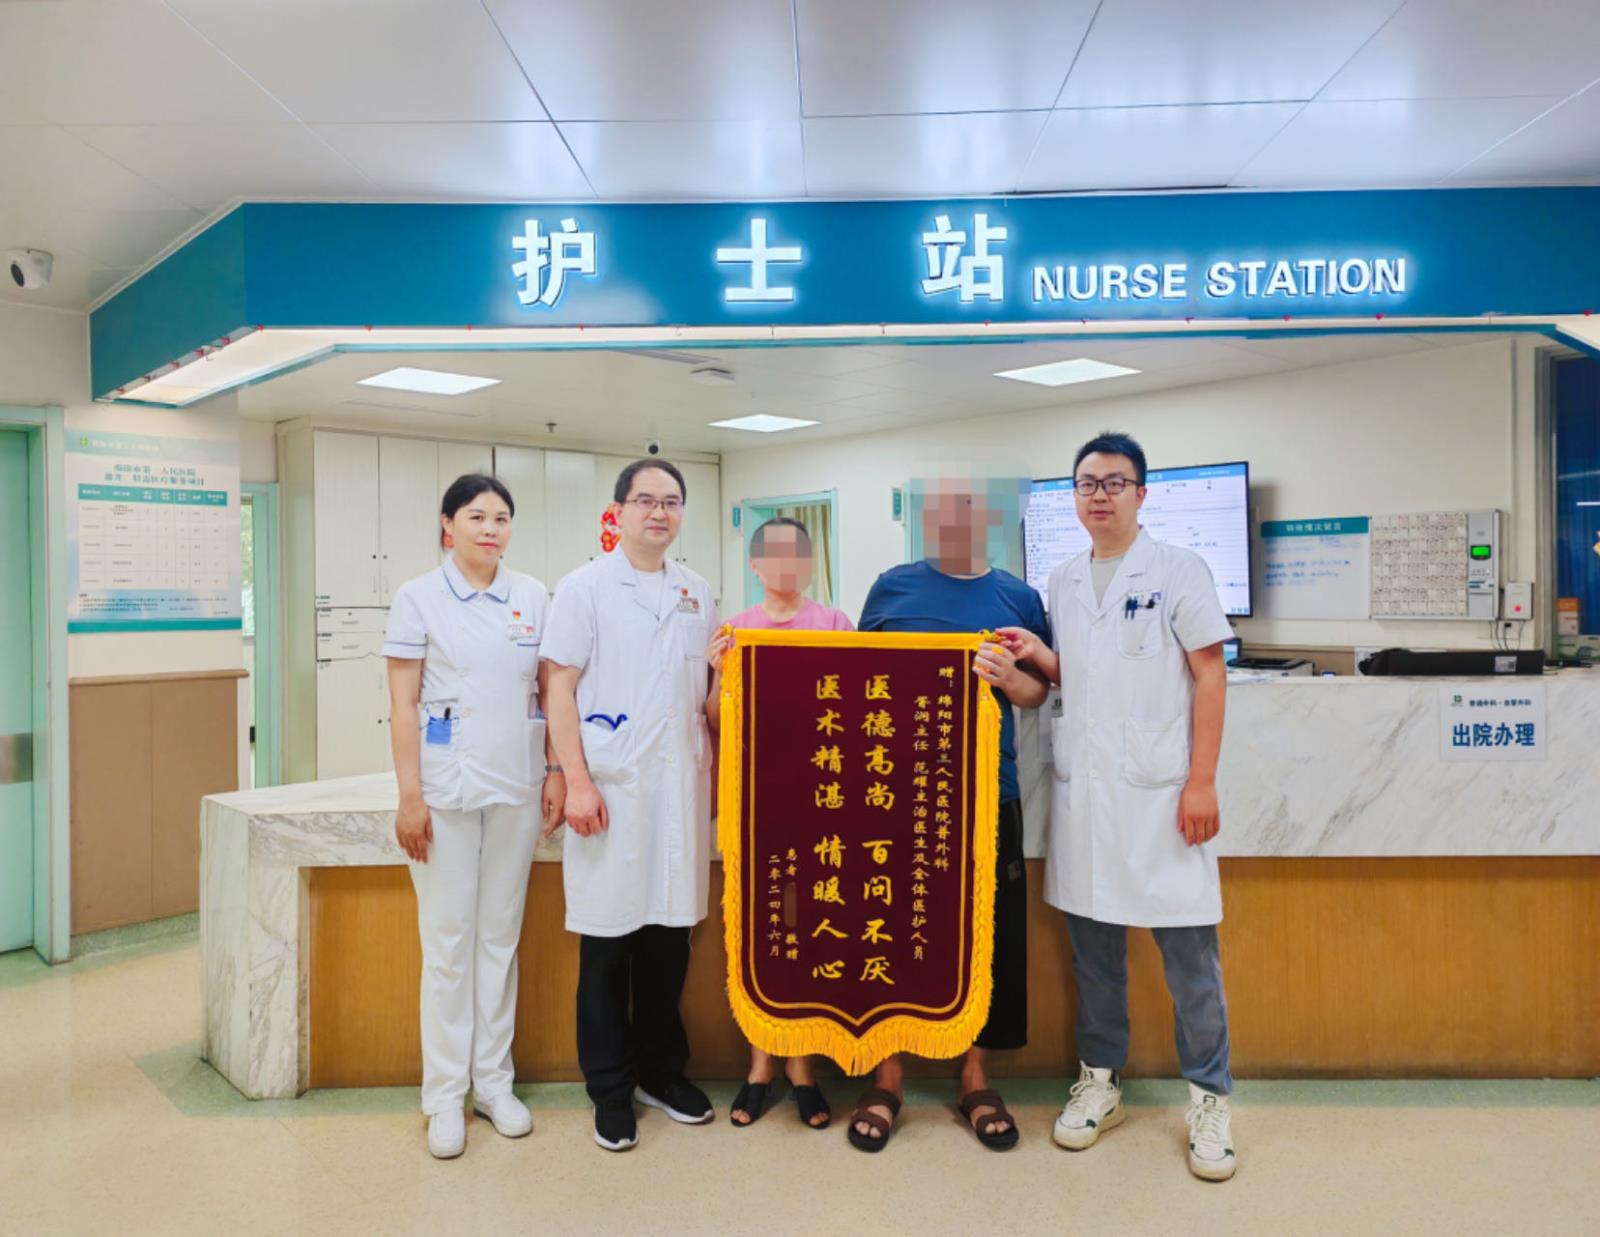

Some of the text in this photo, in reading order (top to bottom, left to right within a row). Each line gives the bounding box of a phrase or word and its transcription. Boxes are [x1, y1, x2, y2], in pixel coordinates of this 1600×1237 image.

[511, 214, 1008, 305] 护士站
[1033, 257, 1407, 301] NURSE STATION
[1452, 722, 1535, 747] 出院办理
[810, 674, 848, 980] 医术精湛 情暖人心
[859, 674, 896, 985] 医德高尚 百问不厌
[768, 854, 782, 957] 二零二四年六月
